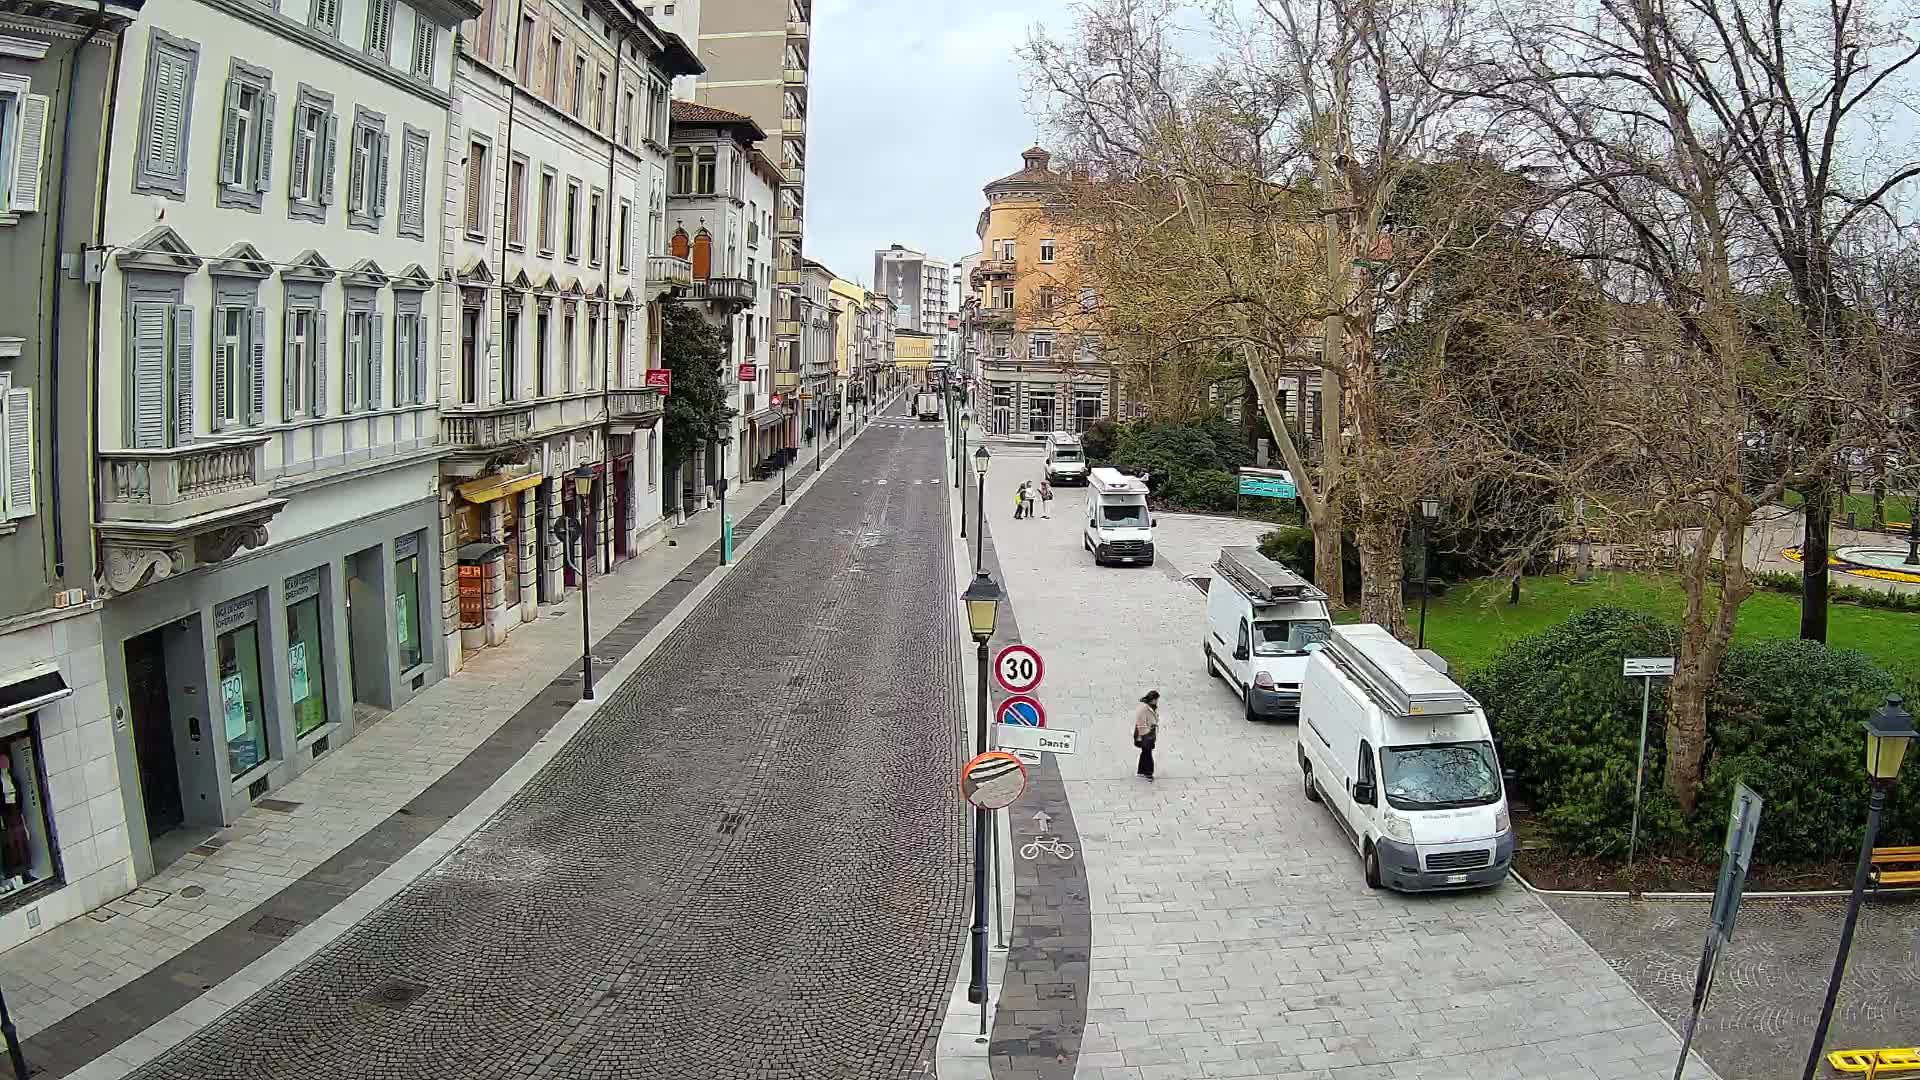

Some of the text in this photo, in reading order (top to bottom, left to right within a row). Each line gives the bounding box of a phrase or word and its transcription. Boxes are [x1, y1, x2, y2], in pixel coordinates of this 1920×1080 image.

[1006, 658, 1032, 680] 30
[223, 678, 240, 700] 130
[1039, 738, 1069, 749] Dante
